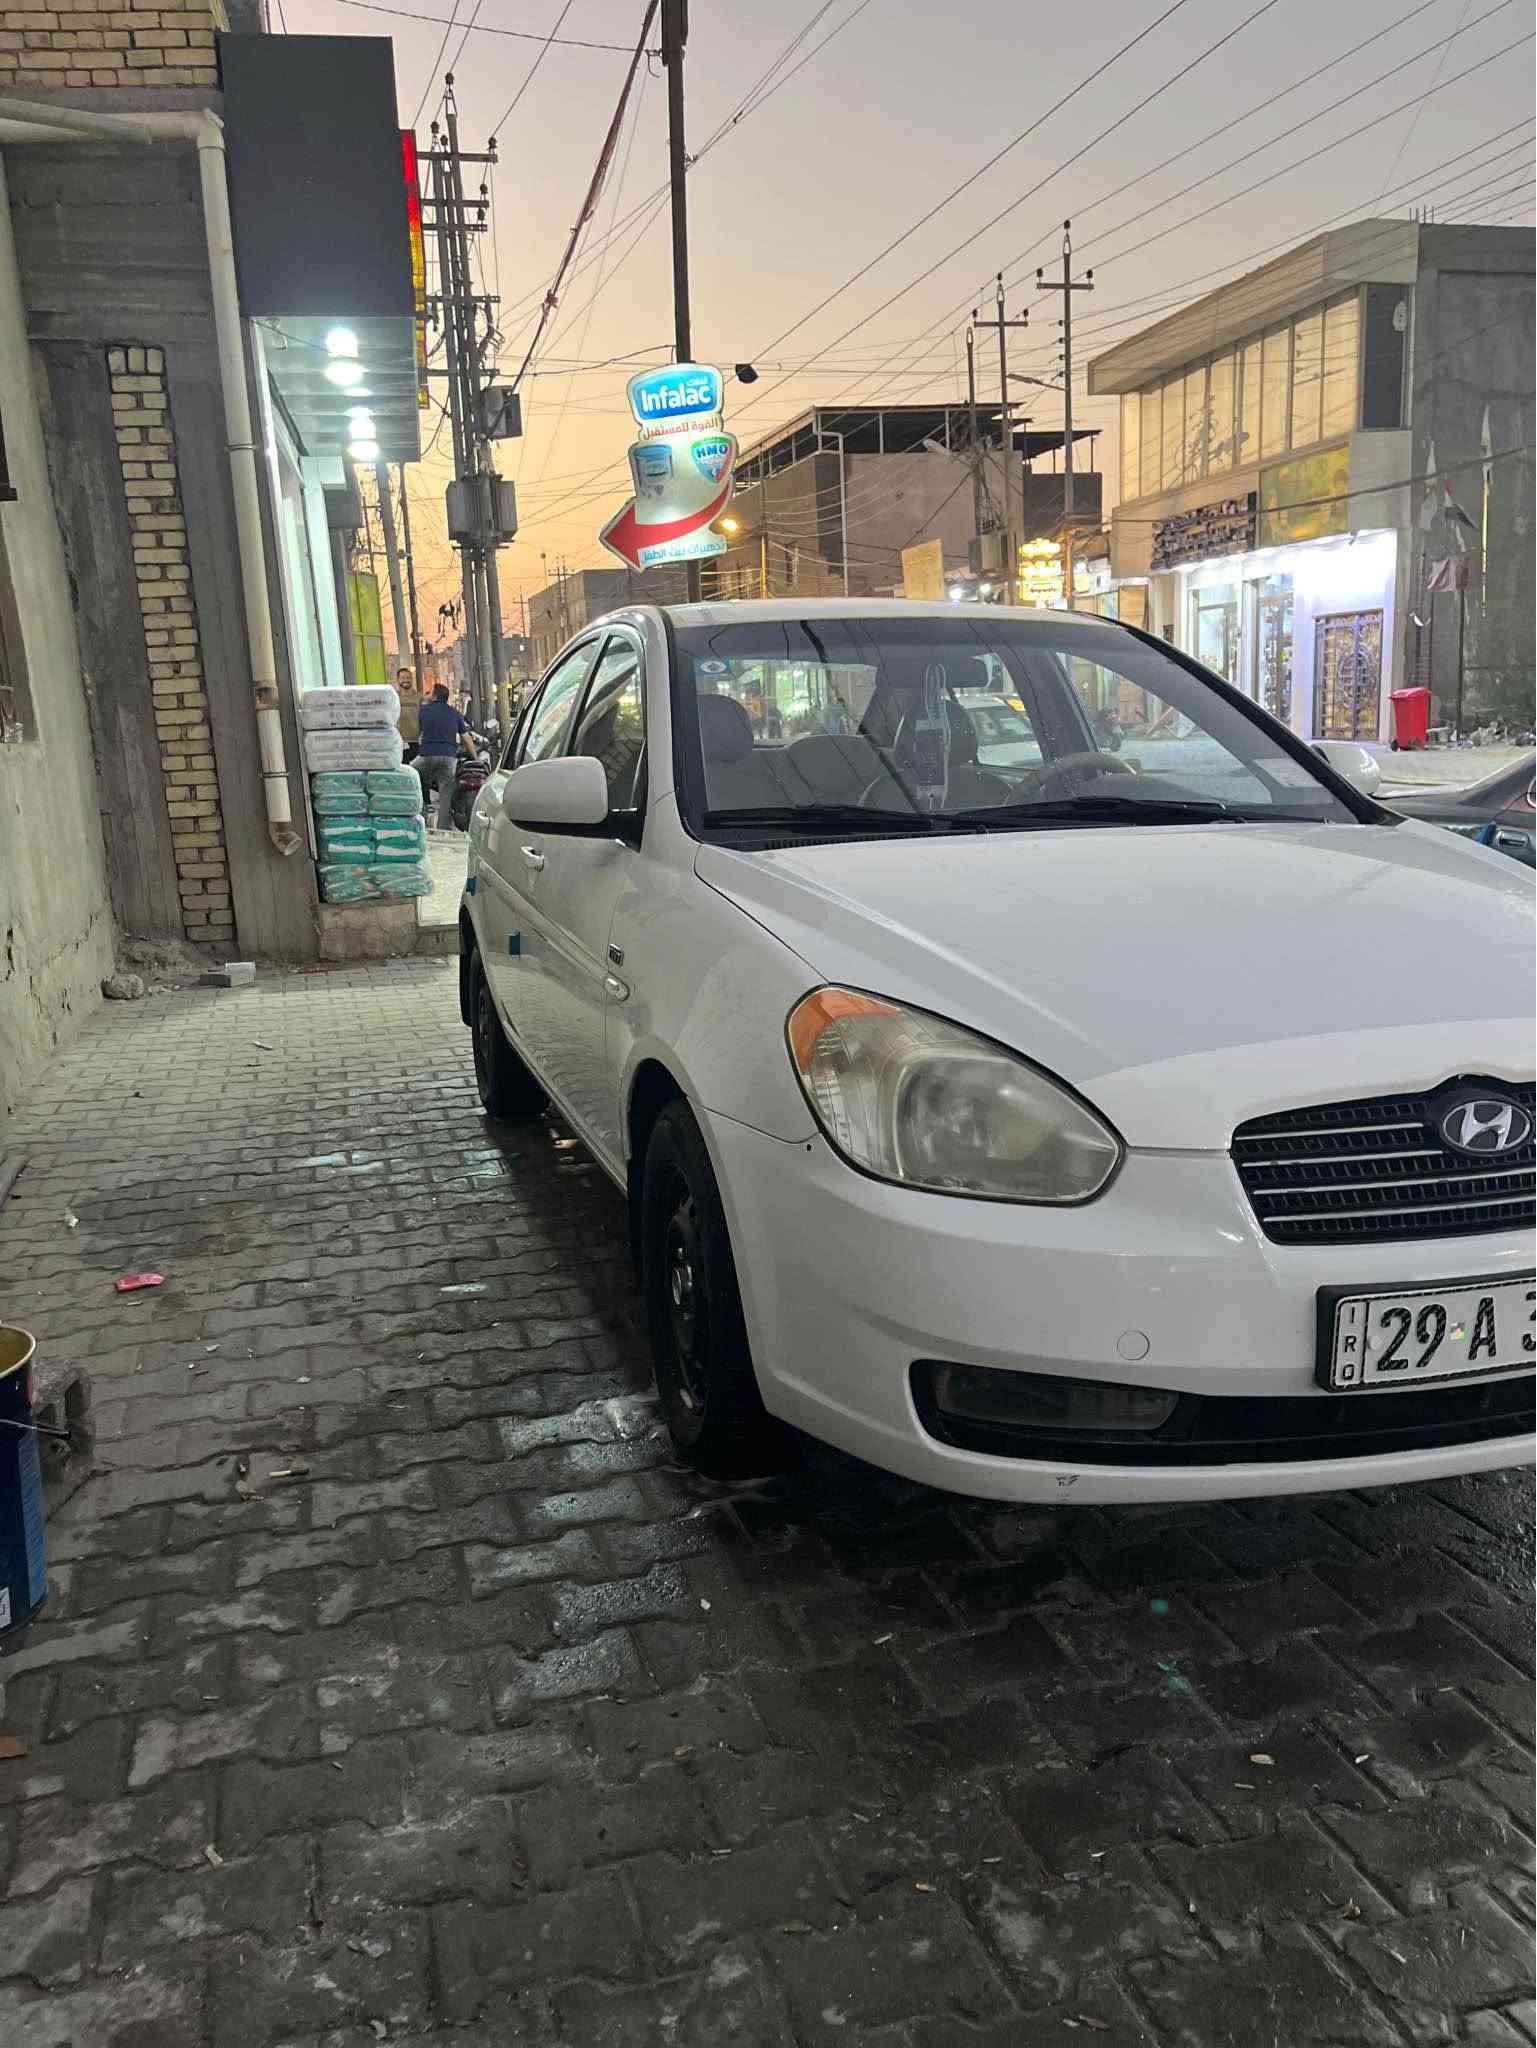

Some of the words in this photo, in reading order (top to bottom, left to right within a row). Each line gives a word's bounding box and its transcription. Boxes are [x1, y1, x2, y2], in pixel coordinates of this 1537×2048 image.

[641, 384, 712, 412] Infalac
[696, 444, 729, 459] HMO
[1376, 1303, 1447, 1371] 29
[1467, 1296, 1496, 1360] A
